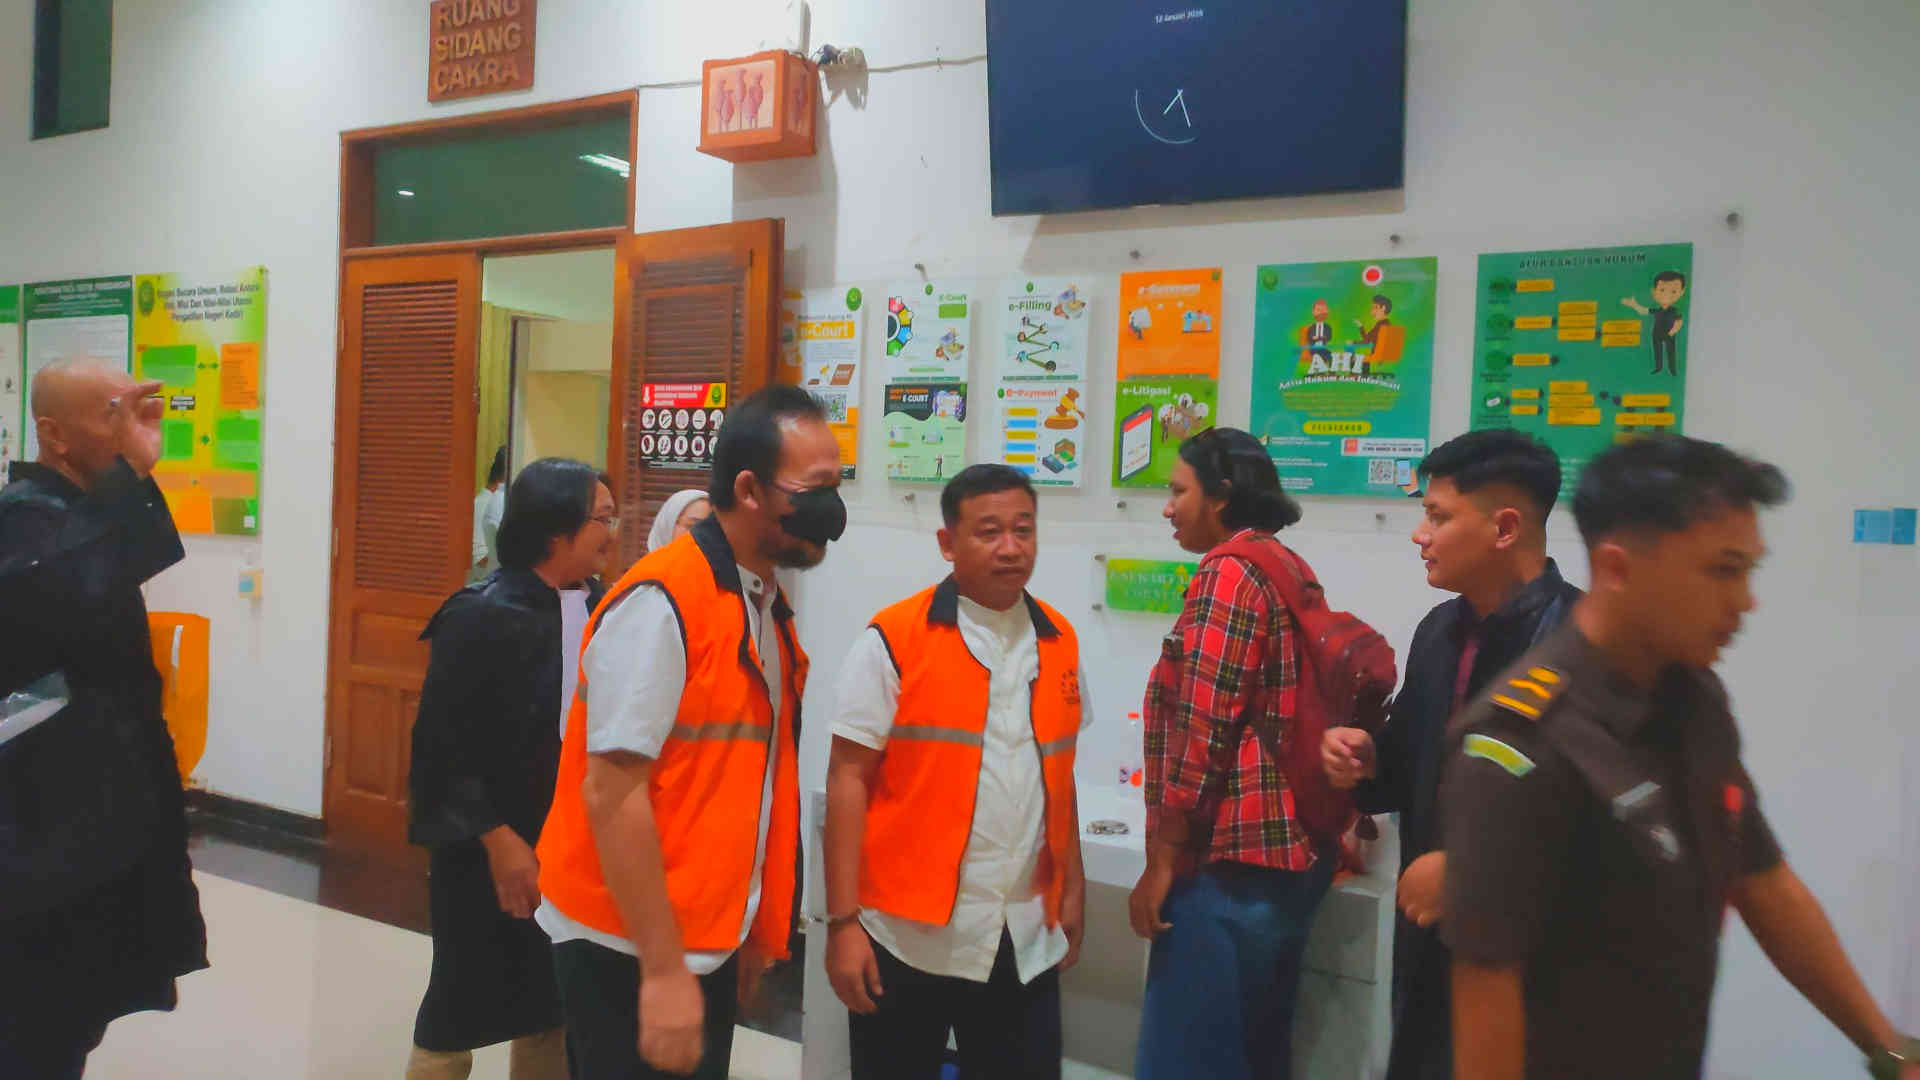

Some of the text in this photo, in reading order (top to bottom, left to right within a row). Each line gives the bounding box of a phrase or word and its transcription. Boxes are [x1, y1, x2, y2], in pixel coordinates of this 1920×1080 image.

[438, 0, 521, 28] RUANG
[435, 22, 521, 61] SIDANG
[434, 60, 520, 93] CAKRA
[1008, 301, 1053, 314] e-Filling
[1308, 352, 1364, 374] AHI
